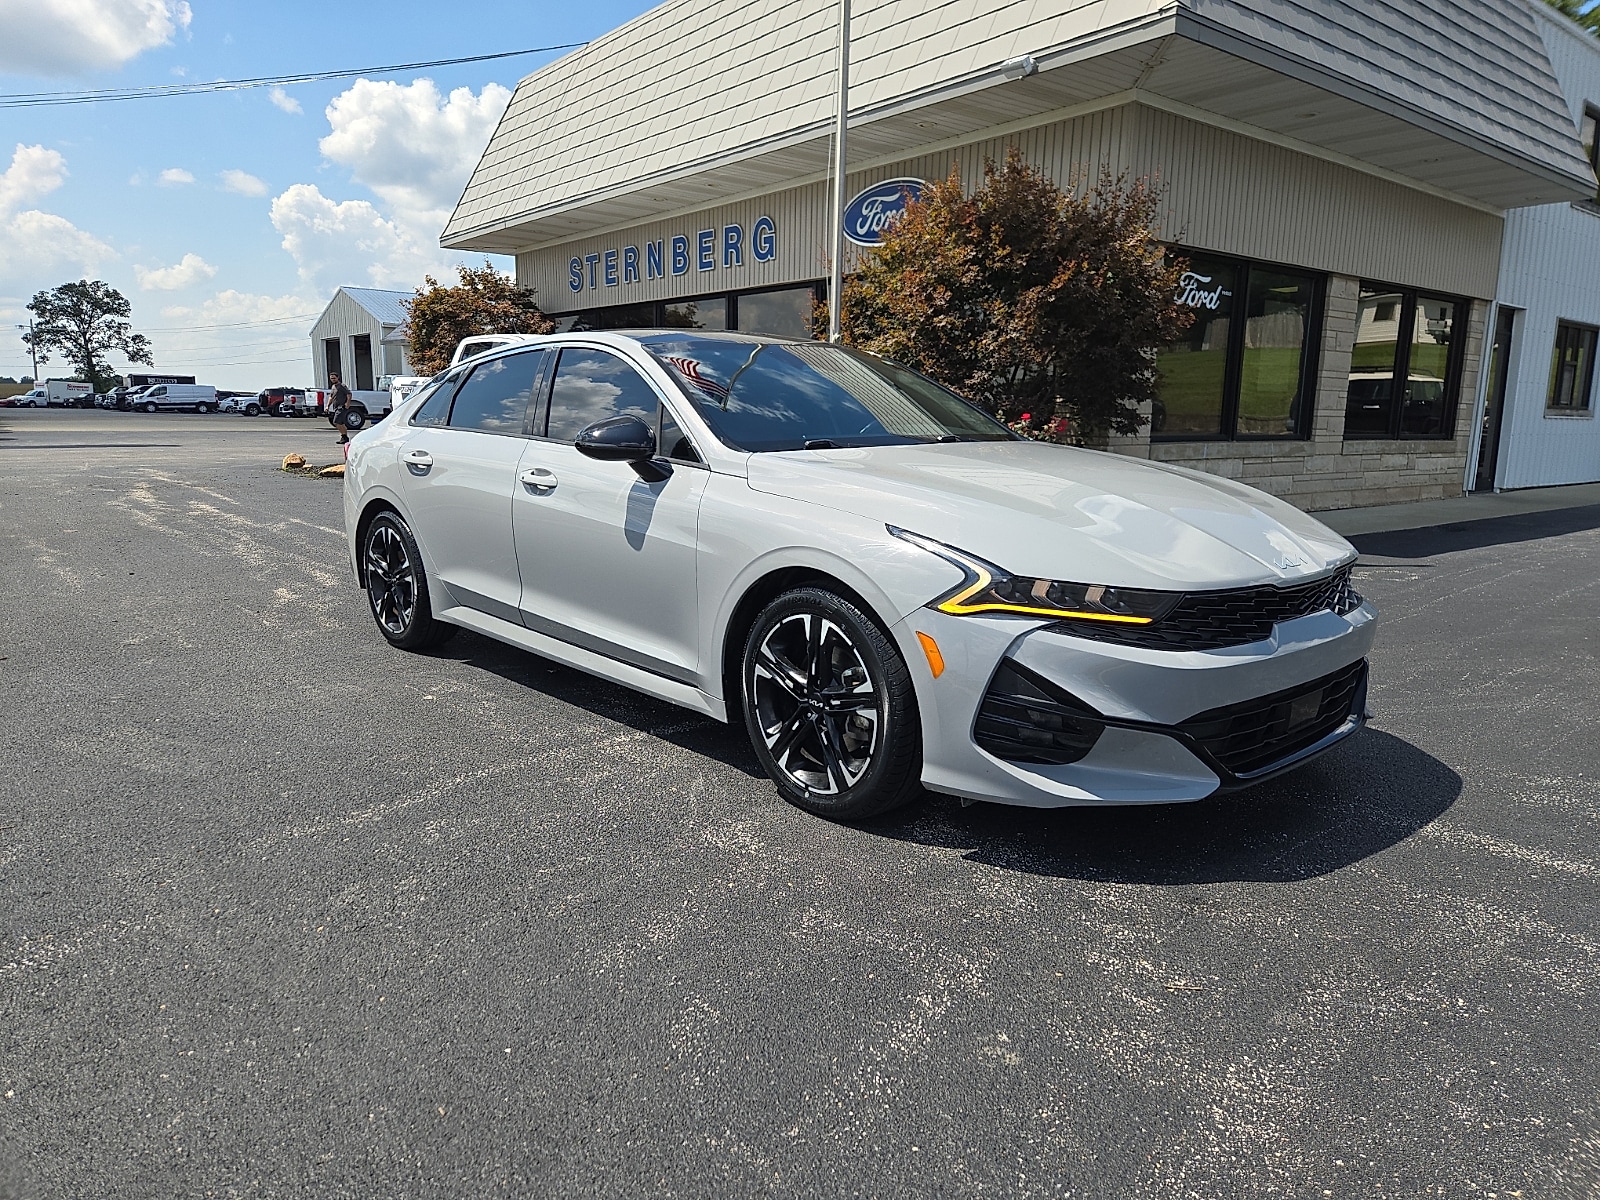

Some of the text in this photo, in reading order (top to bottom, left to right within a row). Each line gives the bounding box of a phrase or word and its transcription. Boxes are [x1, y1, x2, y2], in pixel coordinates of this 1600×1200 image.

[856, 192, 907, 235] For
[568, 215, 776, 293] STERNBERG
[1173, 272, 1223, 310] Ford
